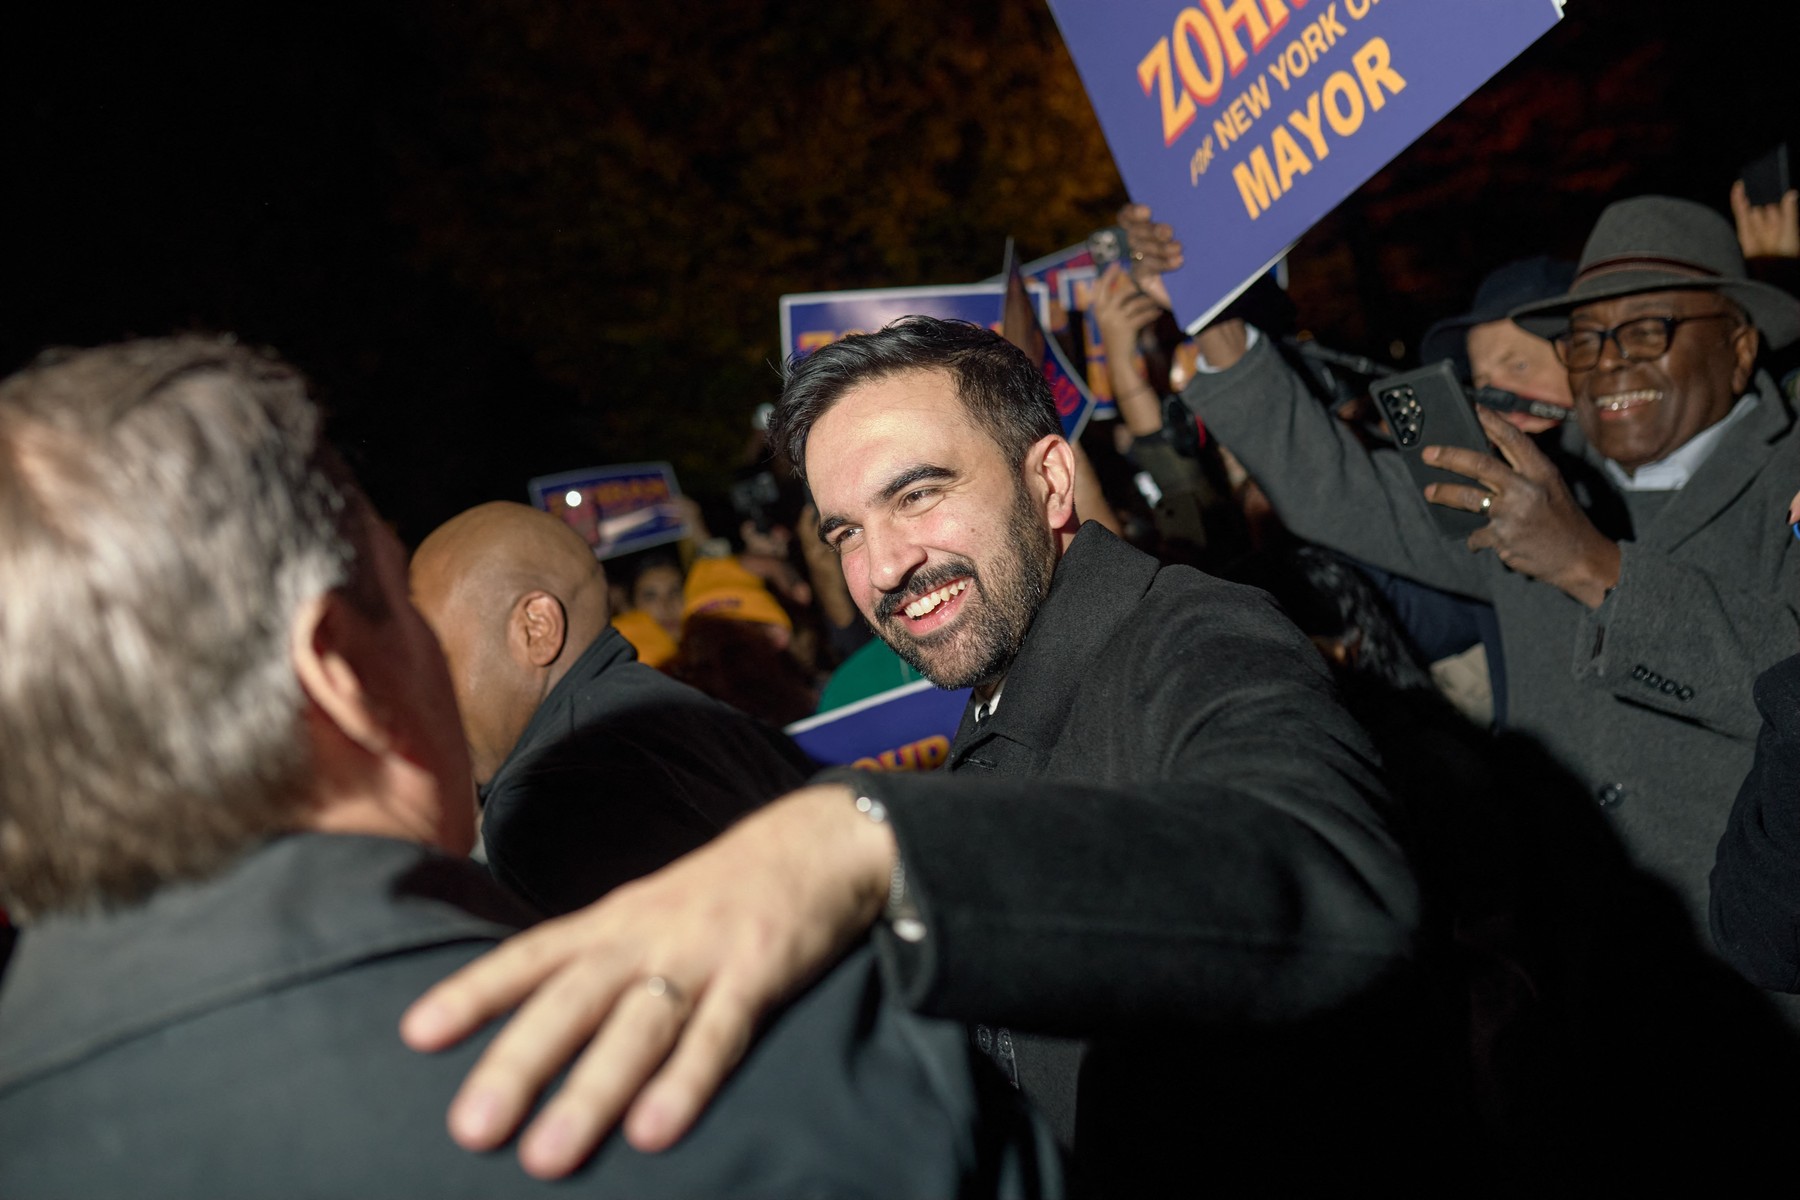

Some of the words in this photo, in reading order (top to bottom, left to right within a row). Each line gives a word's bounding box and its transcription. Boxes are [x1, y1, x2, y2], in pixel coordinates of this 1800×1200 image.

[1212, 73, 1271, 151] NEW
[1267, 1, 1347, 91] YORK
[1232, 36, 1408, 220] MAYOR
